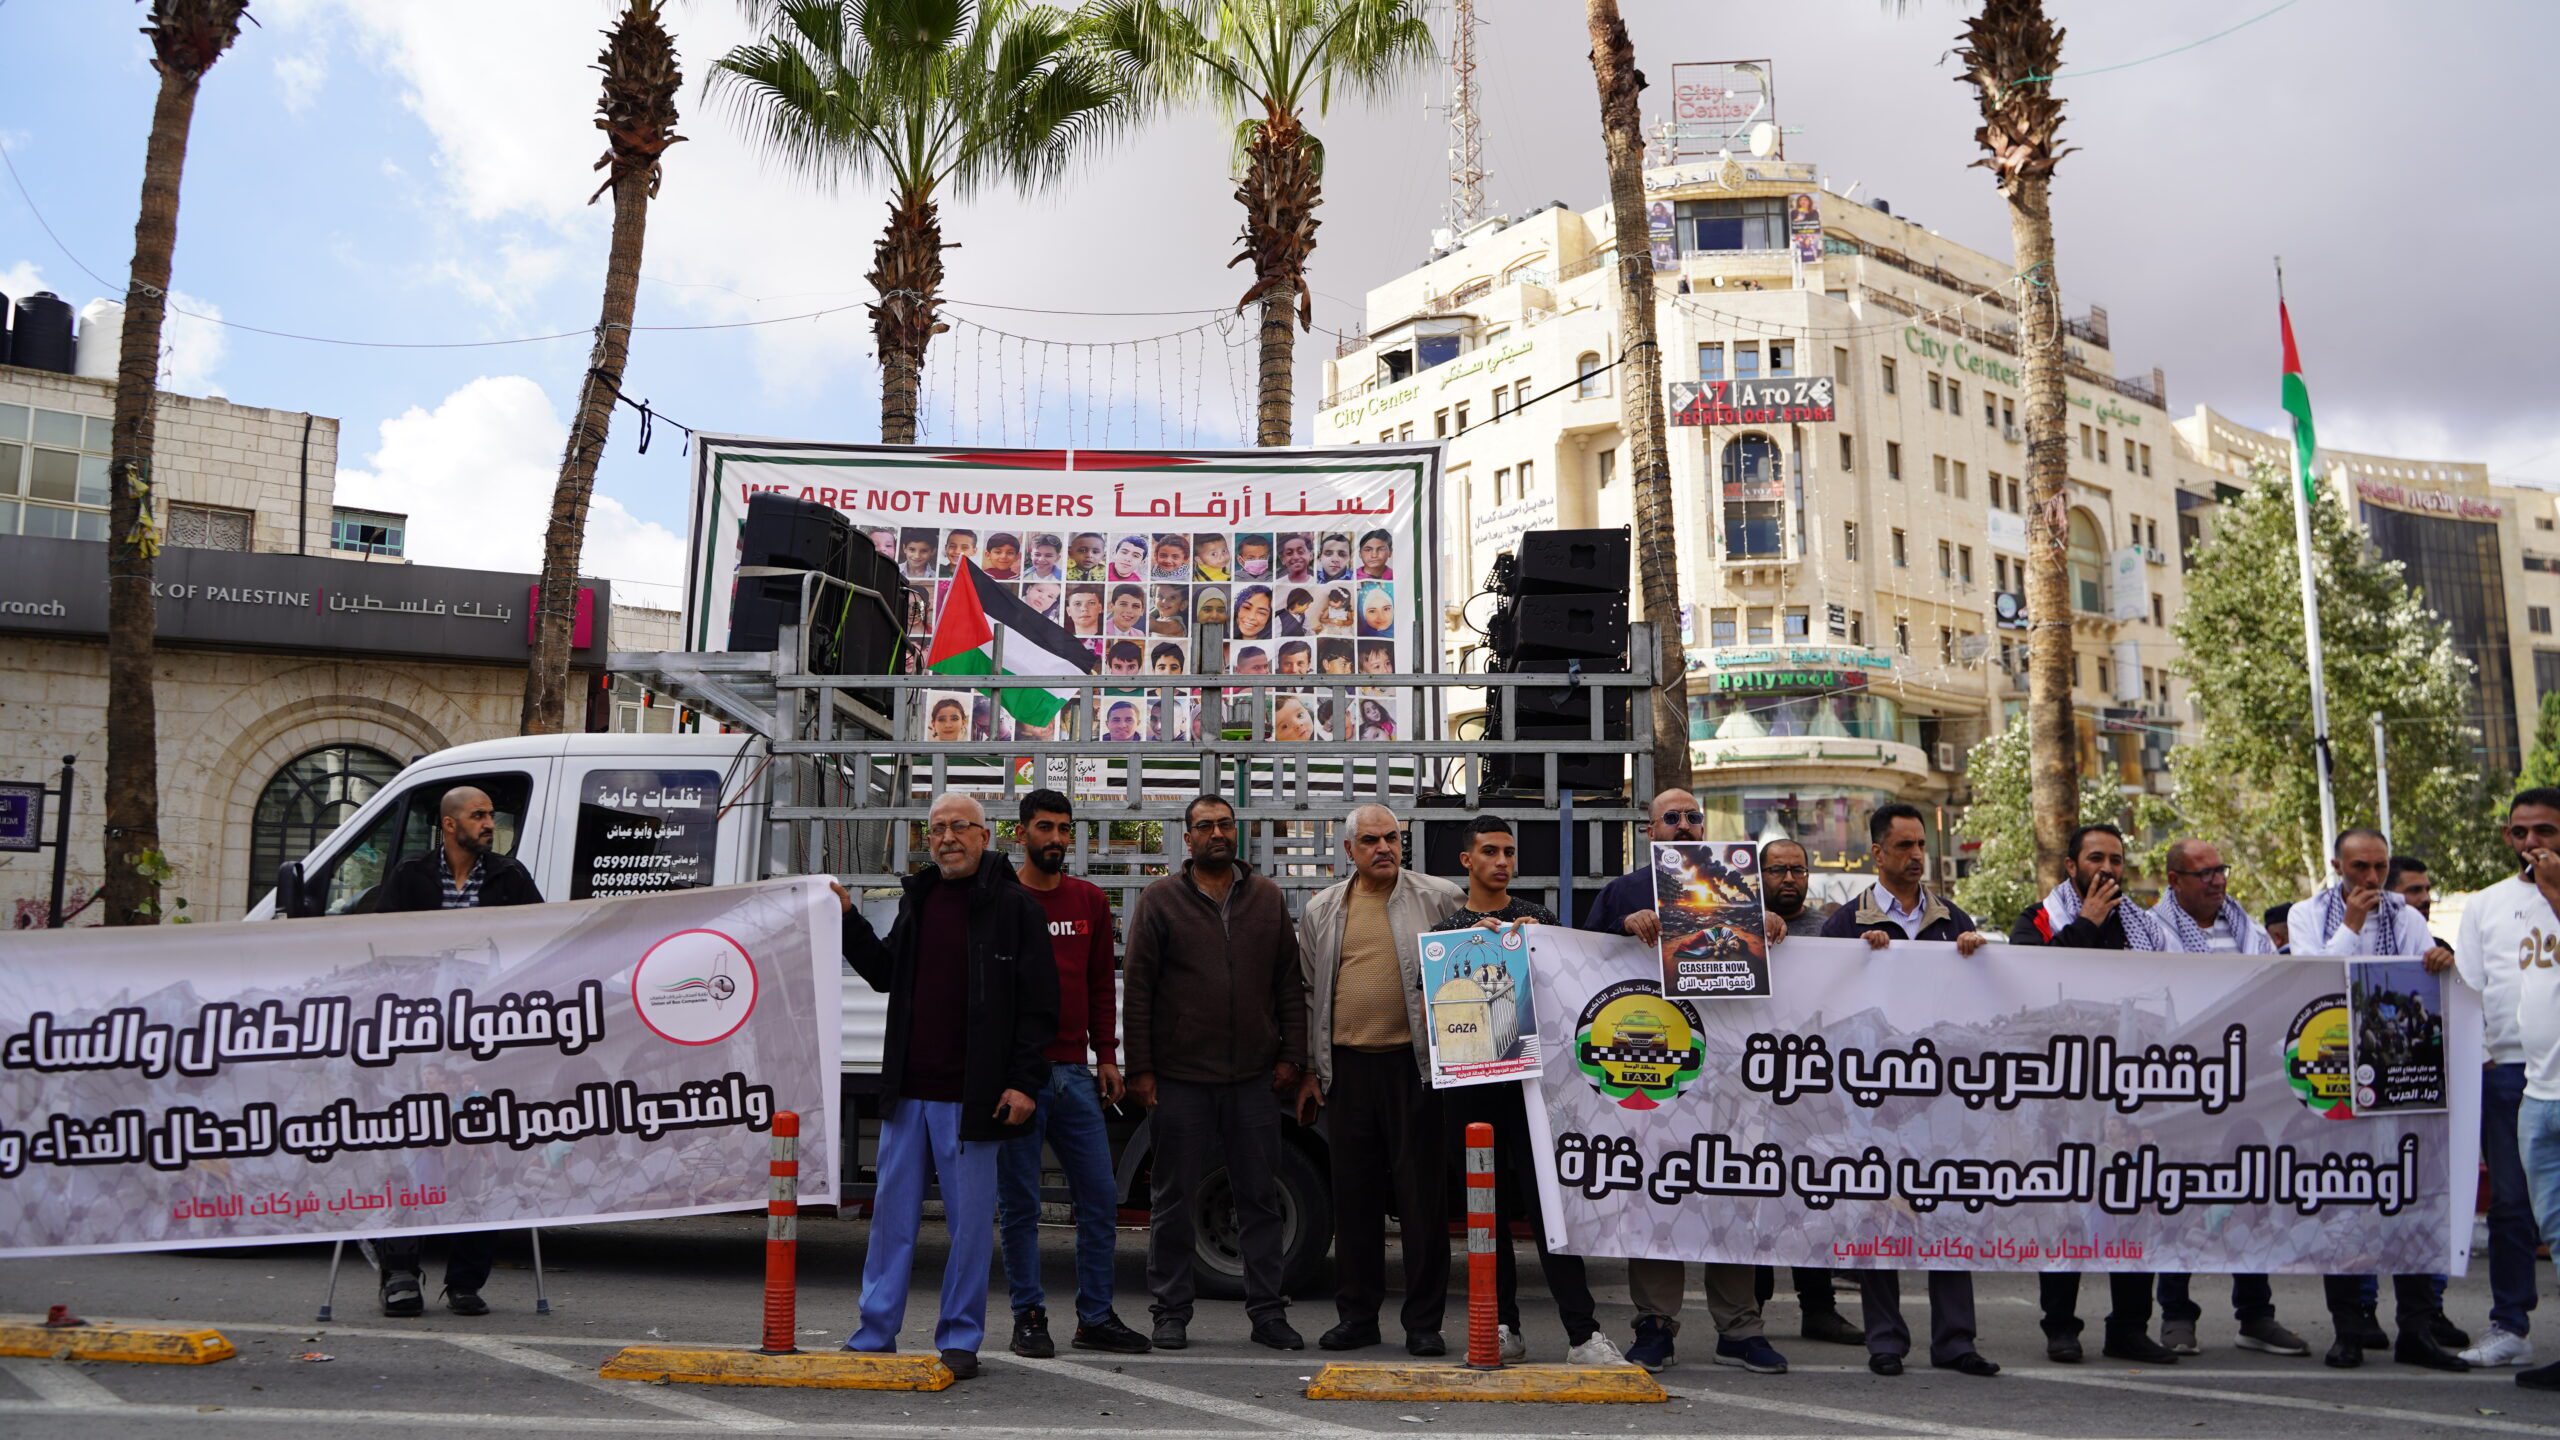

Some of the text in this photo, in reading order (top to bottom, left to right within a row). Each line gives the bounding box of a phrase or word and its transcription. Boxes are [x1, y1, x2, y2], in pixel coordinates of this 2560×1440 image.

[1677, 84, 1727, 103] City
[1679, 102, 1755, 119] Center
[1905, 326, 2020, 388] City Center
[1742, 384, 1757, 406] A
[1760, 388, 1791, 406] TO
[1794, 382, 1811, 405] Z
[1334, 384, 1420, 429] City Center
[1672, 406, 1834, 426] TECHNOLOGY STORE
[799, 486, 858, 511] ARE
[866, 489, 931, 514] NOT
[938, 493, 1095, 518] NUMBERS
[1265, 488, 1395, 517] لسنا
[168, 583, 198, 599] OF
[207, 585, 311, 608] PALESTINE
[329, 591, 512, 623] بنك فلسطين
[0, 600, 67, 617] ranch
[1717, 671, 1835, 689] Hollywood
[597, 785, 702, 813] نقليات عامة
[607, 824, 632, 839] عياش
[593, 855, 671, 868] 0599118175
[592, 873, 670, 886] 0569889557
[1047, 921, 1076, 936] O IT.
[1680, 962, 1749, 973] CEASEFIRE NOW.
[1698, 978, 1724, 990] الحرب
[1725, 974, 1754, 988] أوقفوا
[5, 981, 602, 1076] اوقفوا قتل الاطفال والنساء
[1448, 1023, 1478, 1034] GAZA
[1623, 1072, 1659, 1082] TAXI
[1745, 1024, 2245, 1111] أوقفوا الحرب في غزة
[616, 1076, 771, 1138] وافتحوا
[2389, 1088, 2418, 1103] الحرب
[455, 1086, 610, 1147] الممرات
[31, 1113, 144, 1162] الغذاء
[151, 1104, 276, 1167] لادخال
[1557, 1134, 2418, 1213] أوقفوا العدوان الهمجي في قطاع غزة
[173, 1179, 447, 1221] نقابة أصحاب شركات الباصات
[1833, 1233, 2143, 1264] نقابة أصحاب شركات مكاتب التكاسي
